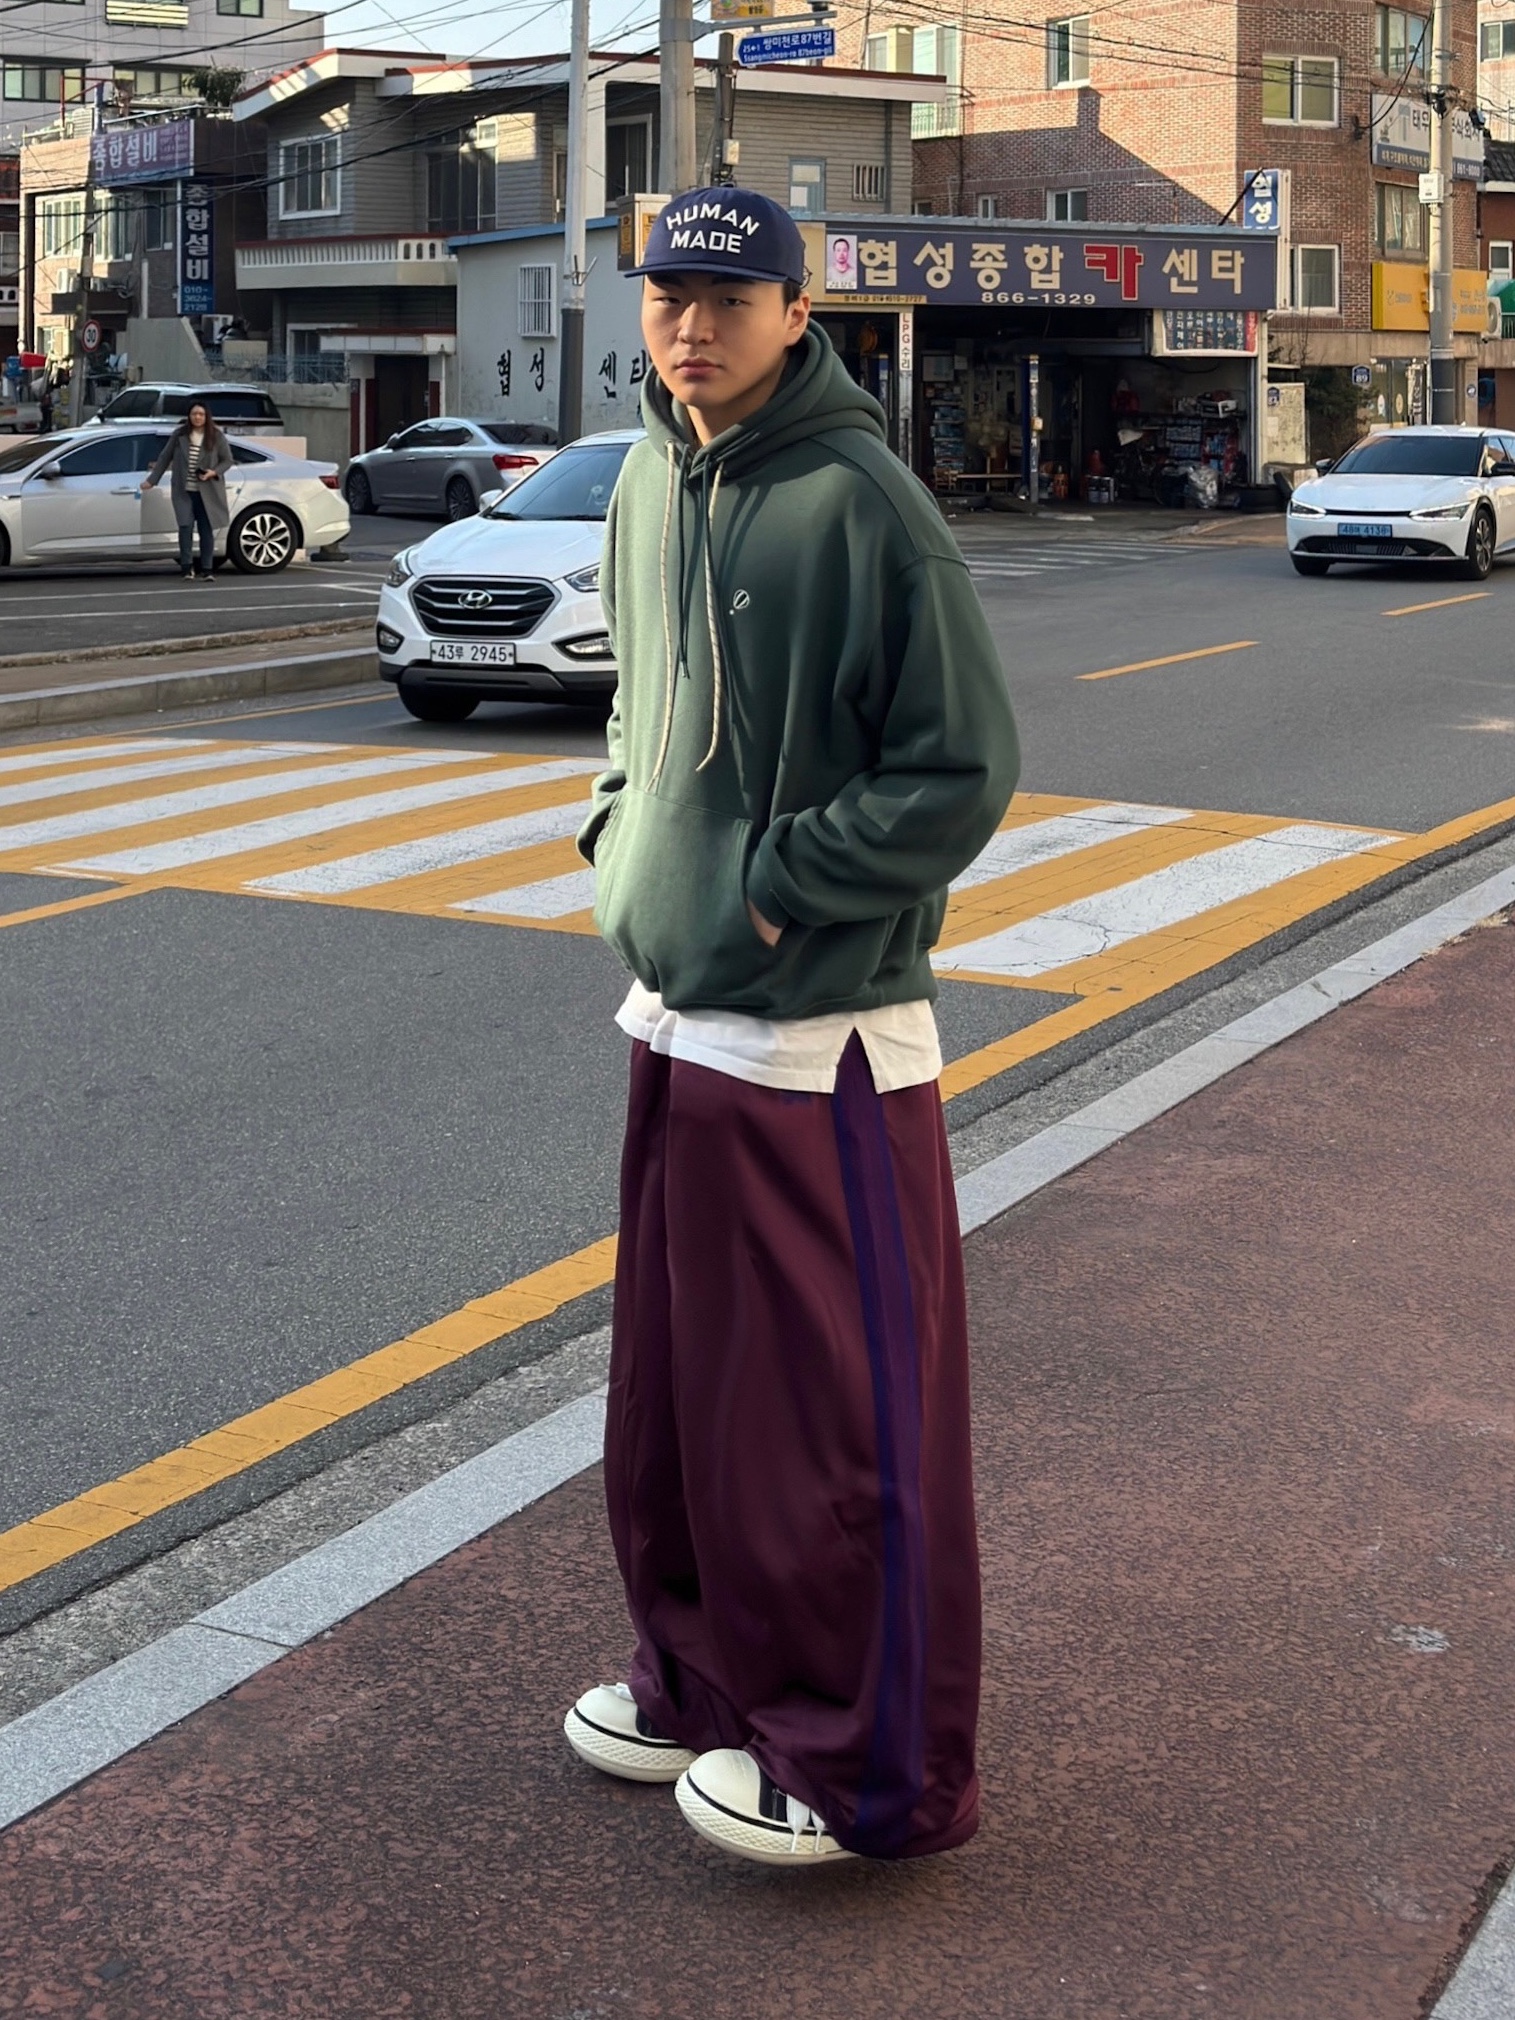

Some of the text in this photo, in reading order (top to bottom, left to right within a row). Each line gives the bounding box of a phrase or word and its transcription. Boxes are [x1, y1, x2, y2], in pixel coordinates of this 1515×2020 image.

[93, 130, 158, 171] 종합설비
[666, 203, 760, 236] HUMAN
[185, 184, 210, 280] 종합설비
[670, 230, 743, 254] MADE
[981, 291, 1096, 305] 866-1329
[86, 329, 97, 343] 30
[902, 314, 911, 344] LPG
[902, 347, 911, 369] 수리
[437, 644, 507, 662] 43루 2945
